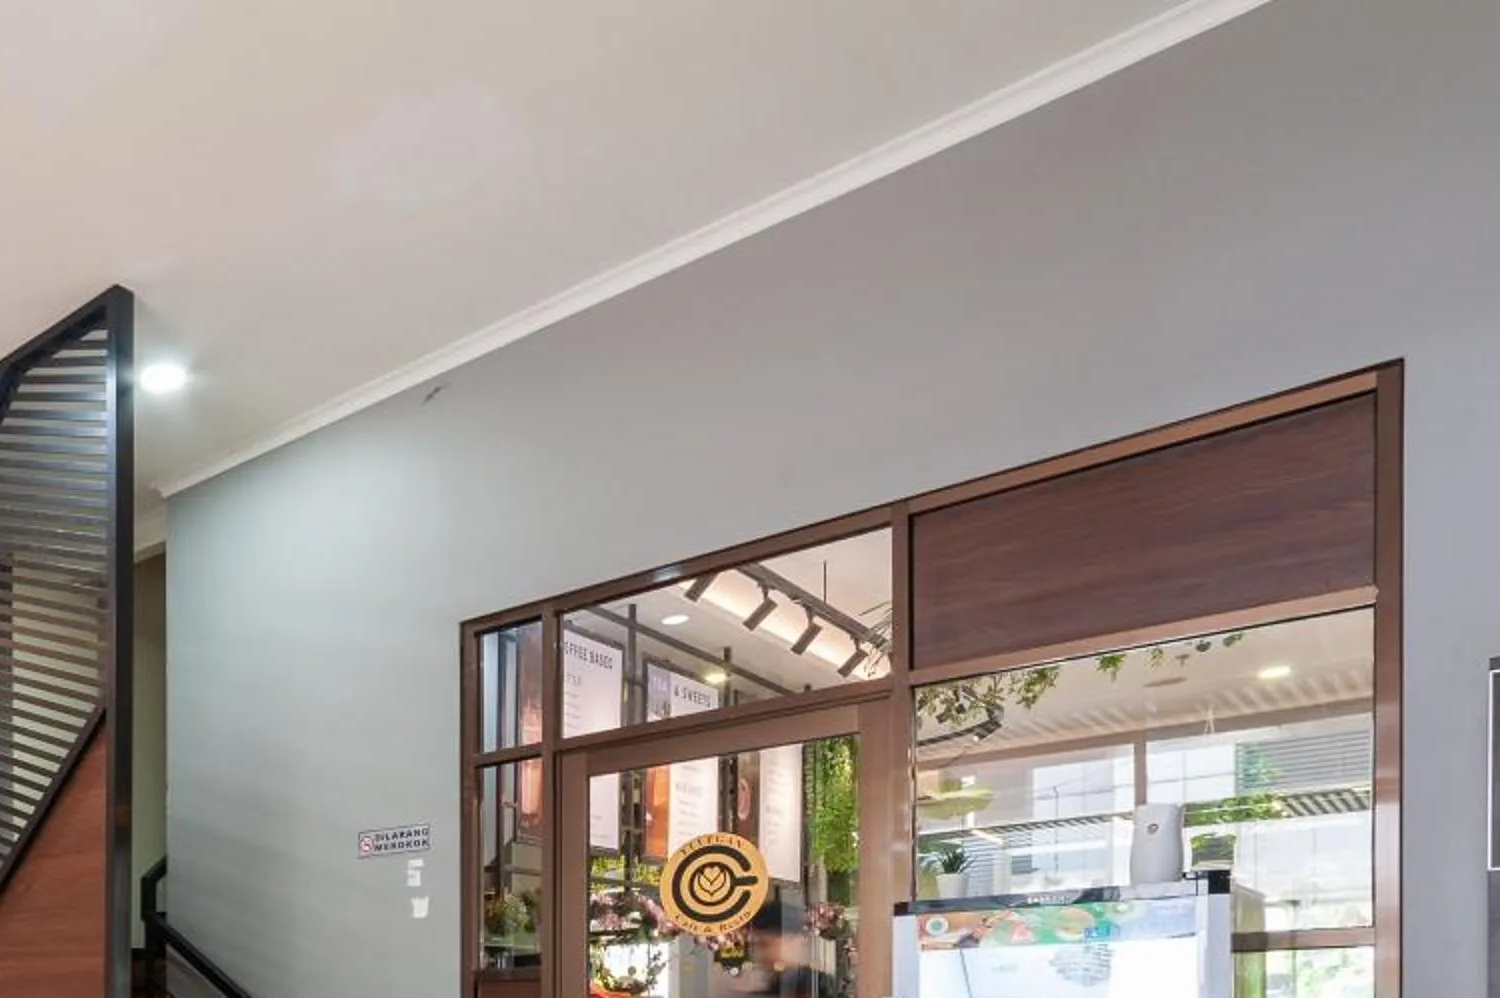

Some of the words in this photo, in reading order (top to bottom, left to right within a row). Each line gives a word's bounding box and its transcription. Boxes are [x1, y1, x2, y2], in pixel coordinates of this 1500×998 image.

[564, 641, 588, 661] OFFEE
[375, 827, 429, 842] DILARANG
[374, 839, 429, 852] MEROKOK
